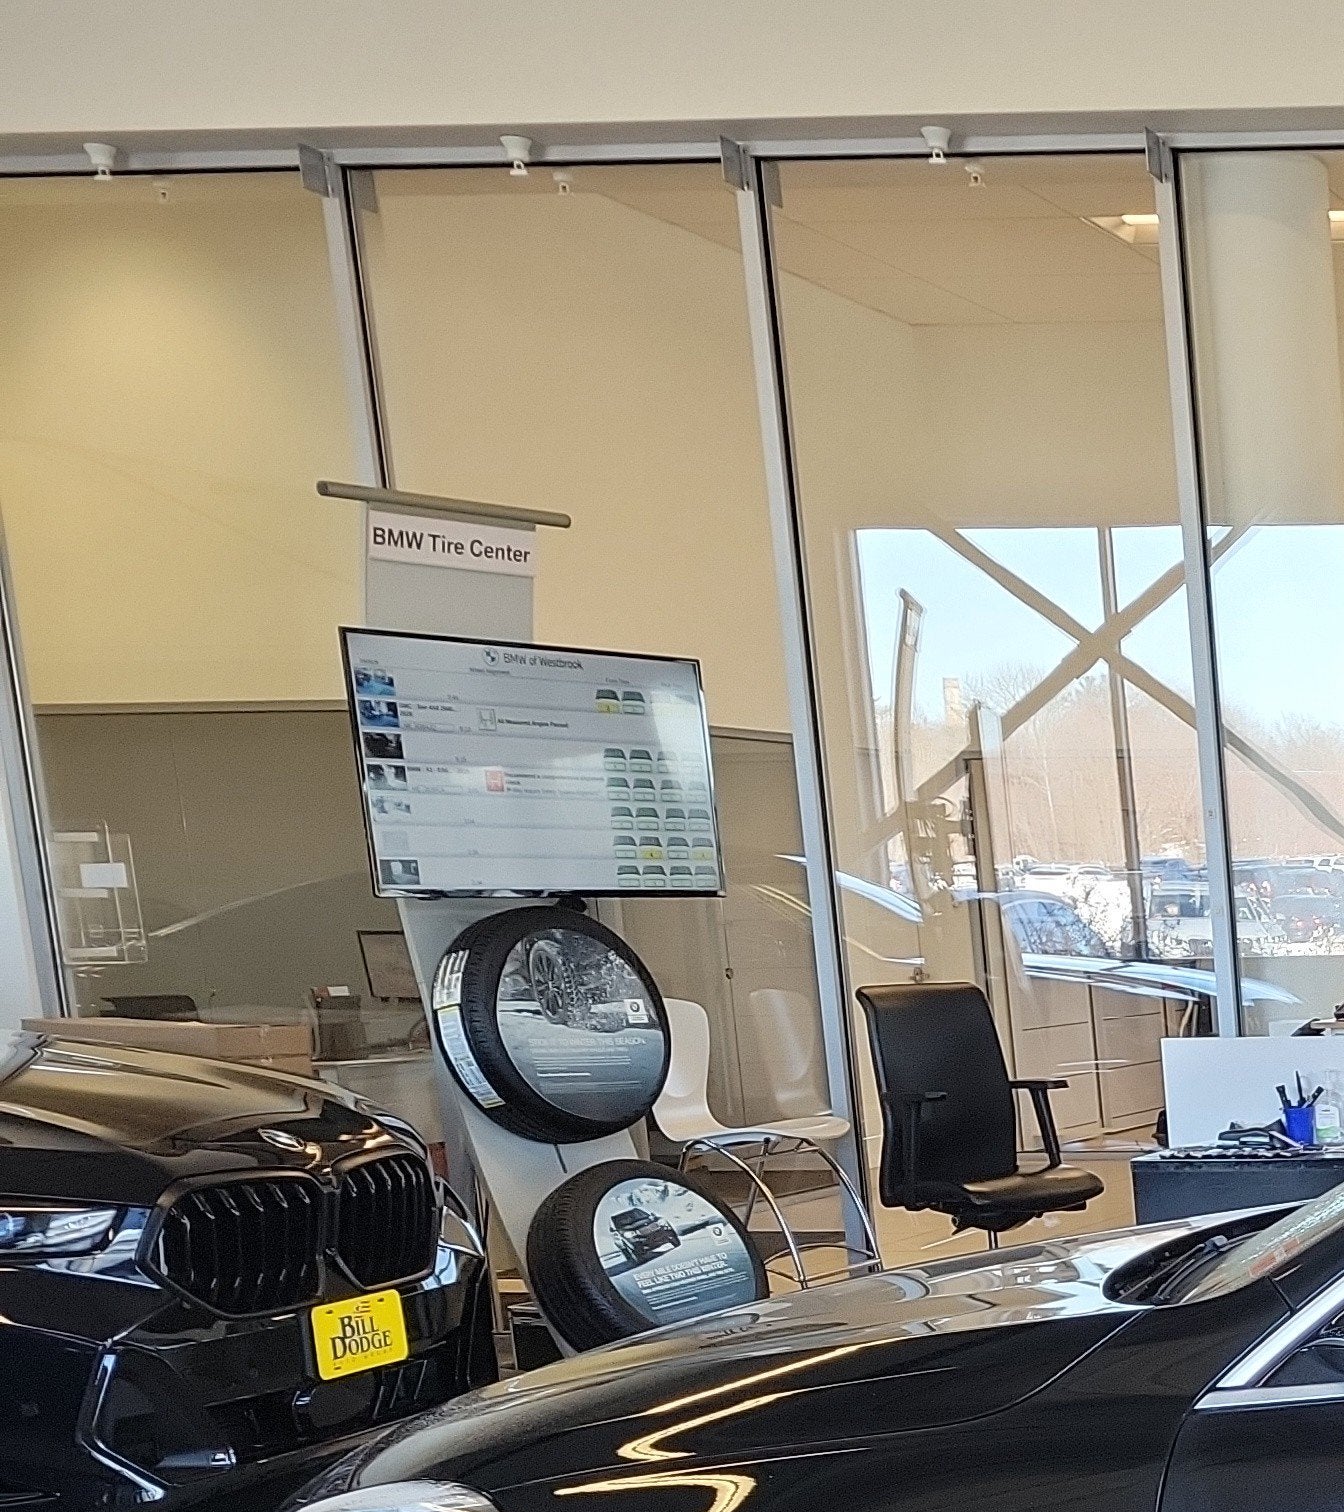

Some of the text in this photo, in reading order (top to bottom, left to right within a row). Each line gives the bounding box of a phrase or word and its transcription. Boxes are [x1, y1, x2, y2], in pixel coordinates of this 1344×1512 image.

[372, 526, 531, 563] BMW Tire Center
[503, 653, 584, 670] BMW of Westbrook
[716, 1252, 728, 1260] TO
[637, 1279, 655, 1289] FEEL
[338, 1315, 379, 1339] BILL
[330, 1330, 393, 1360] DODGE
